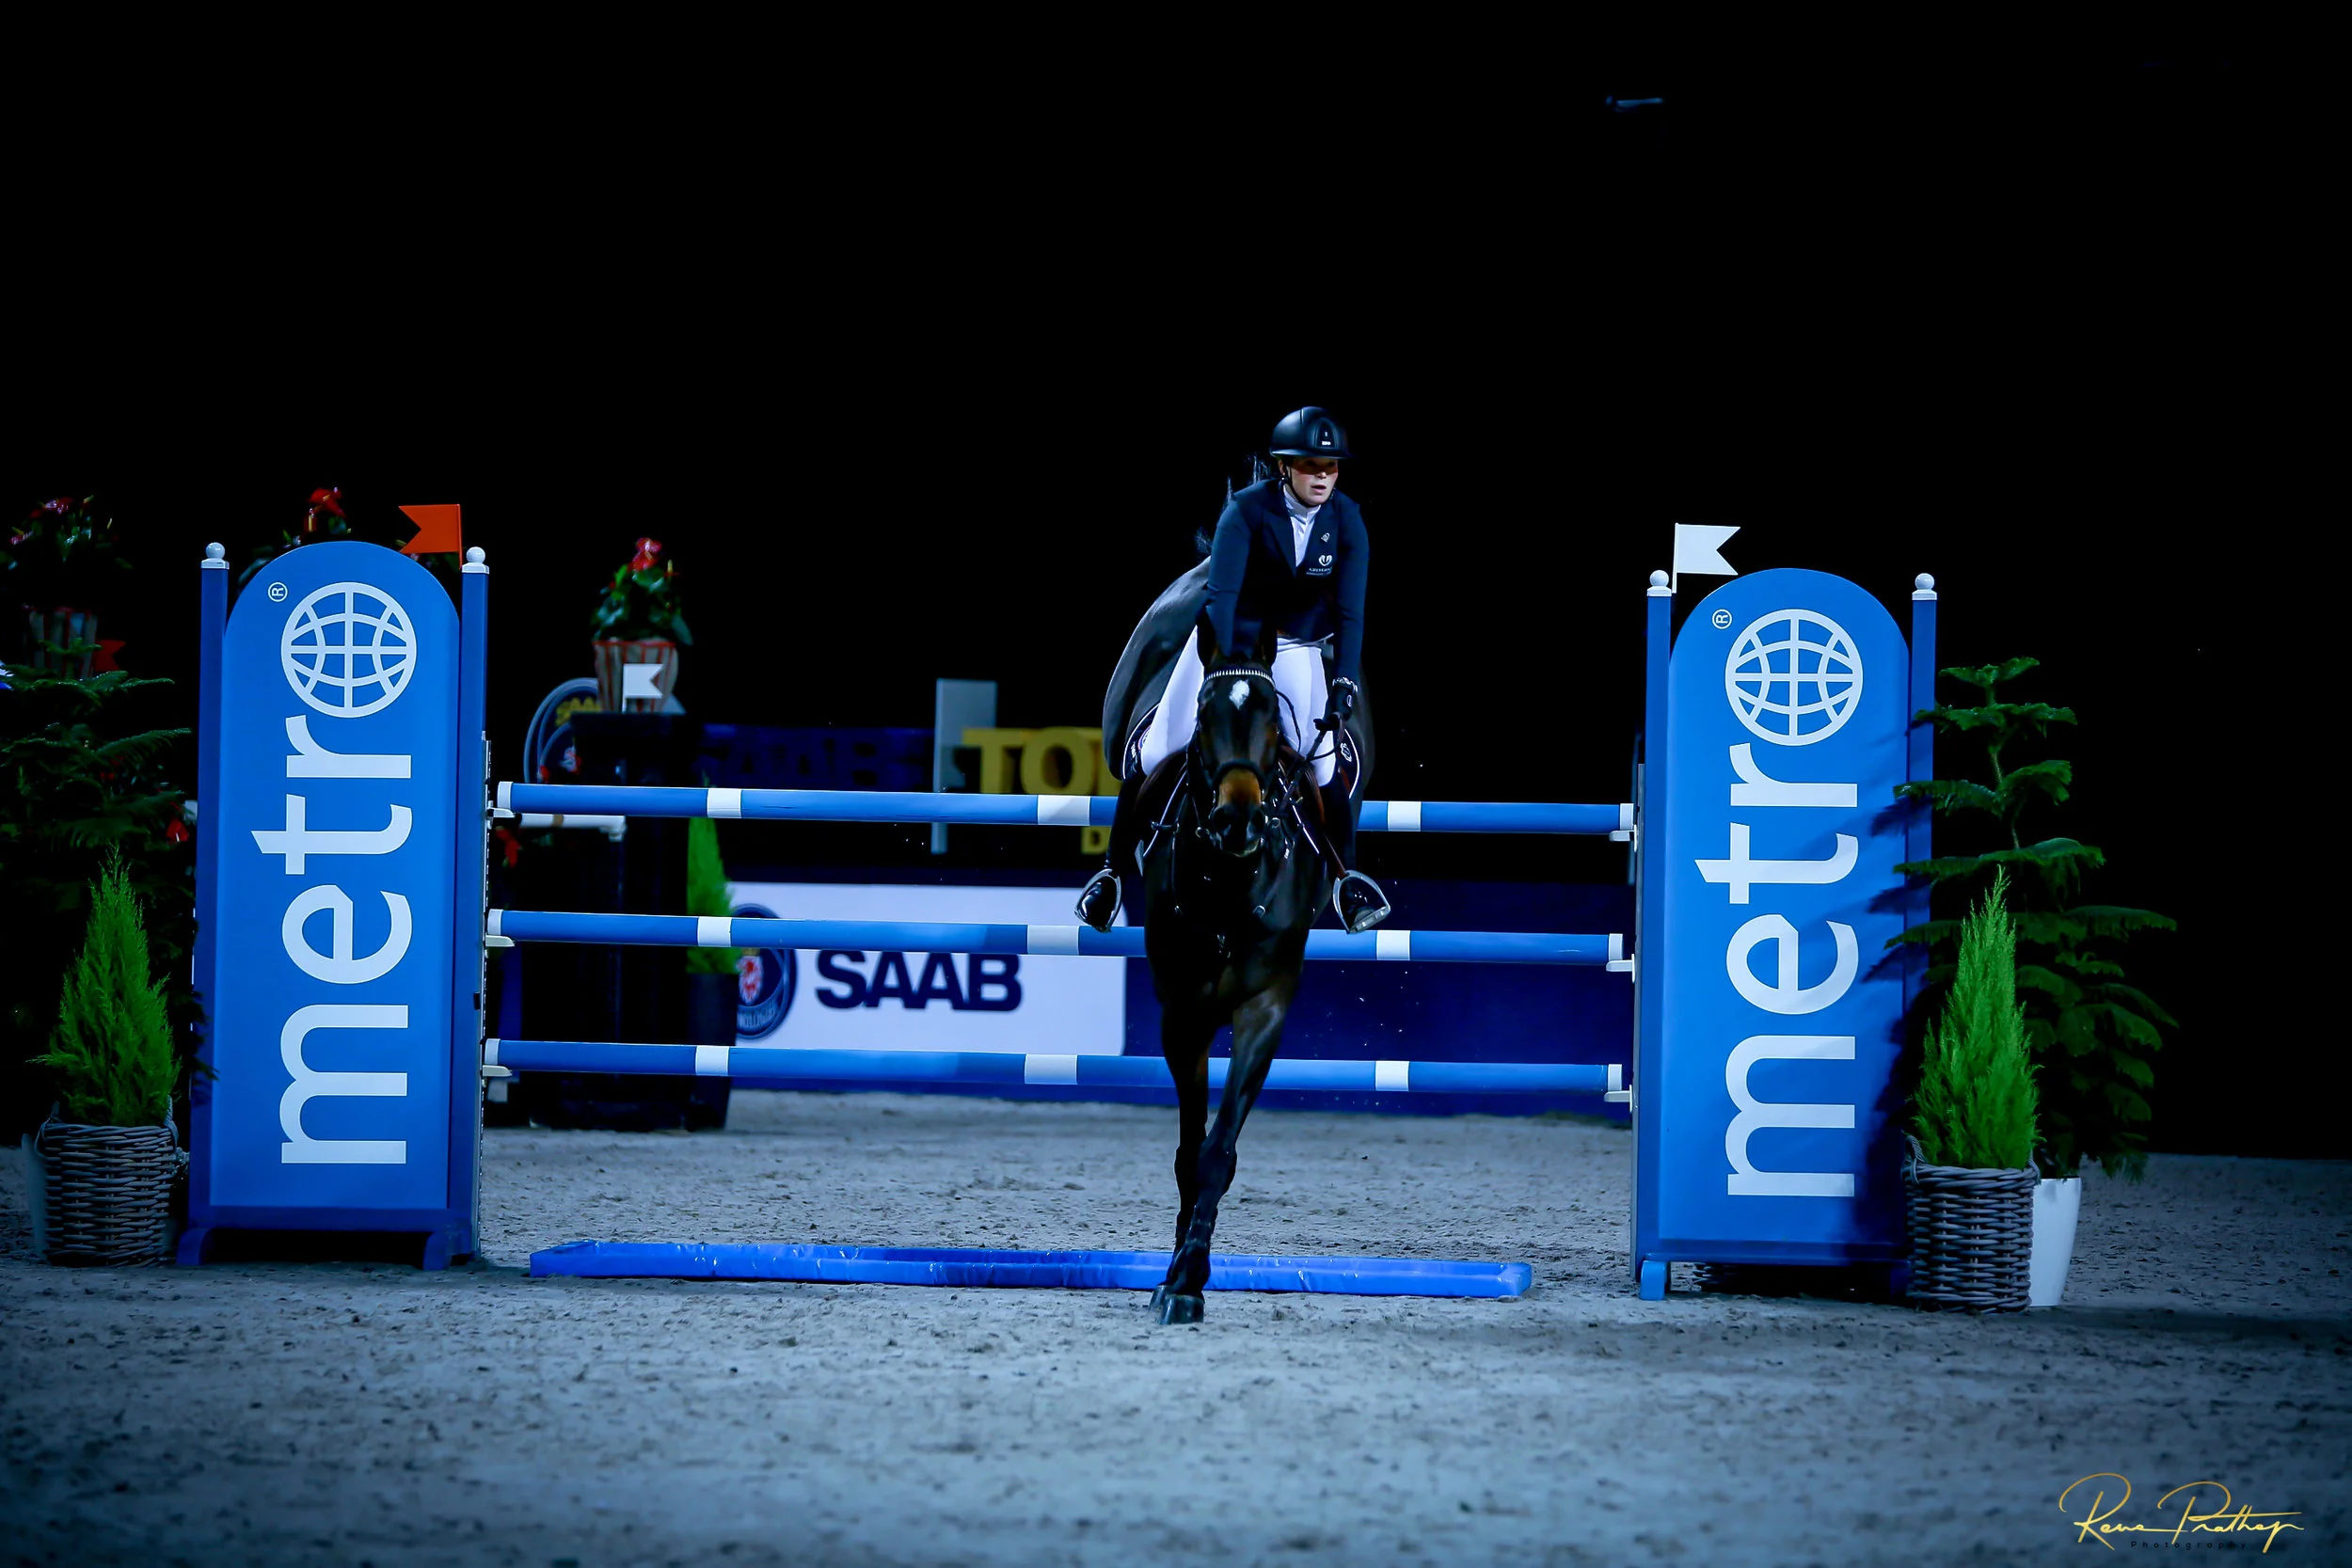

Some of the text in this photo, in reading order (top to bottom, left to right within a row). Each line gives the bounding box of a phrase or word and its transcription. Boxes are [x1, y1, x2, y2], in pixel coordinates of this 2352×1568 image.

[250, 581, 418, 1165] metro
[816, 948, 1024, 1012] SAAB
[1695, 609, 1864, 1198] metro
